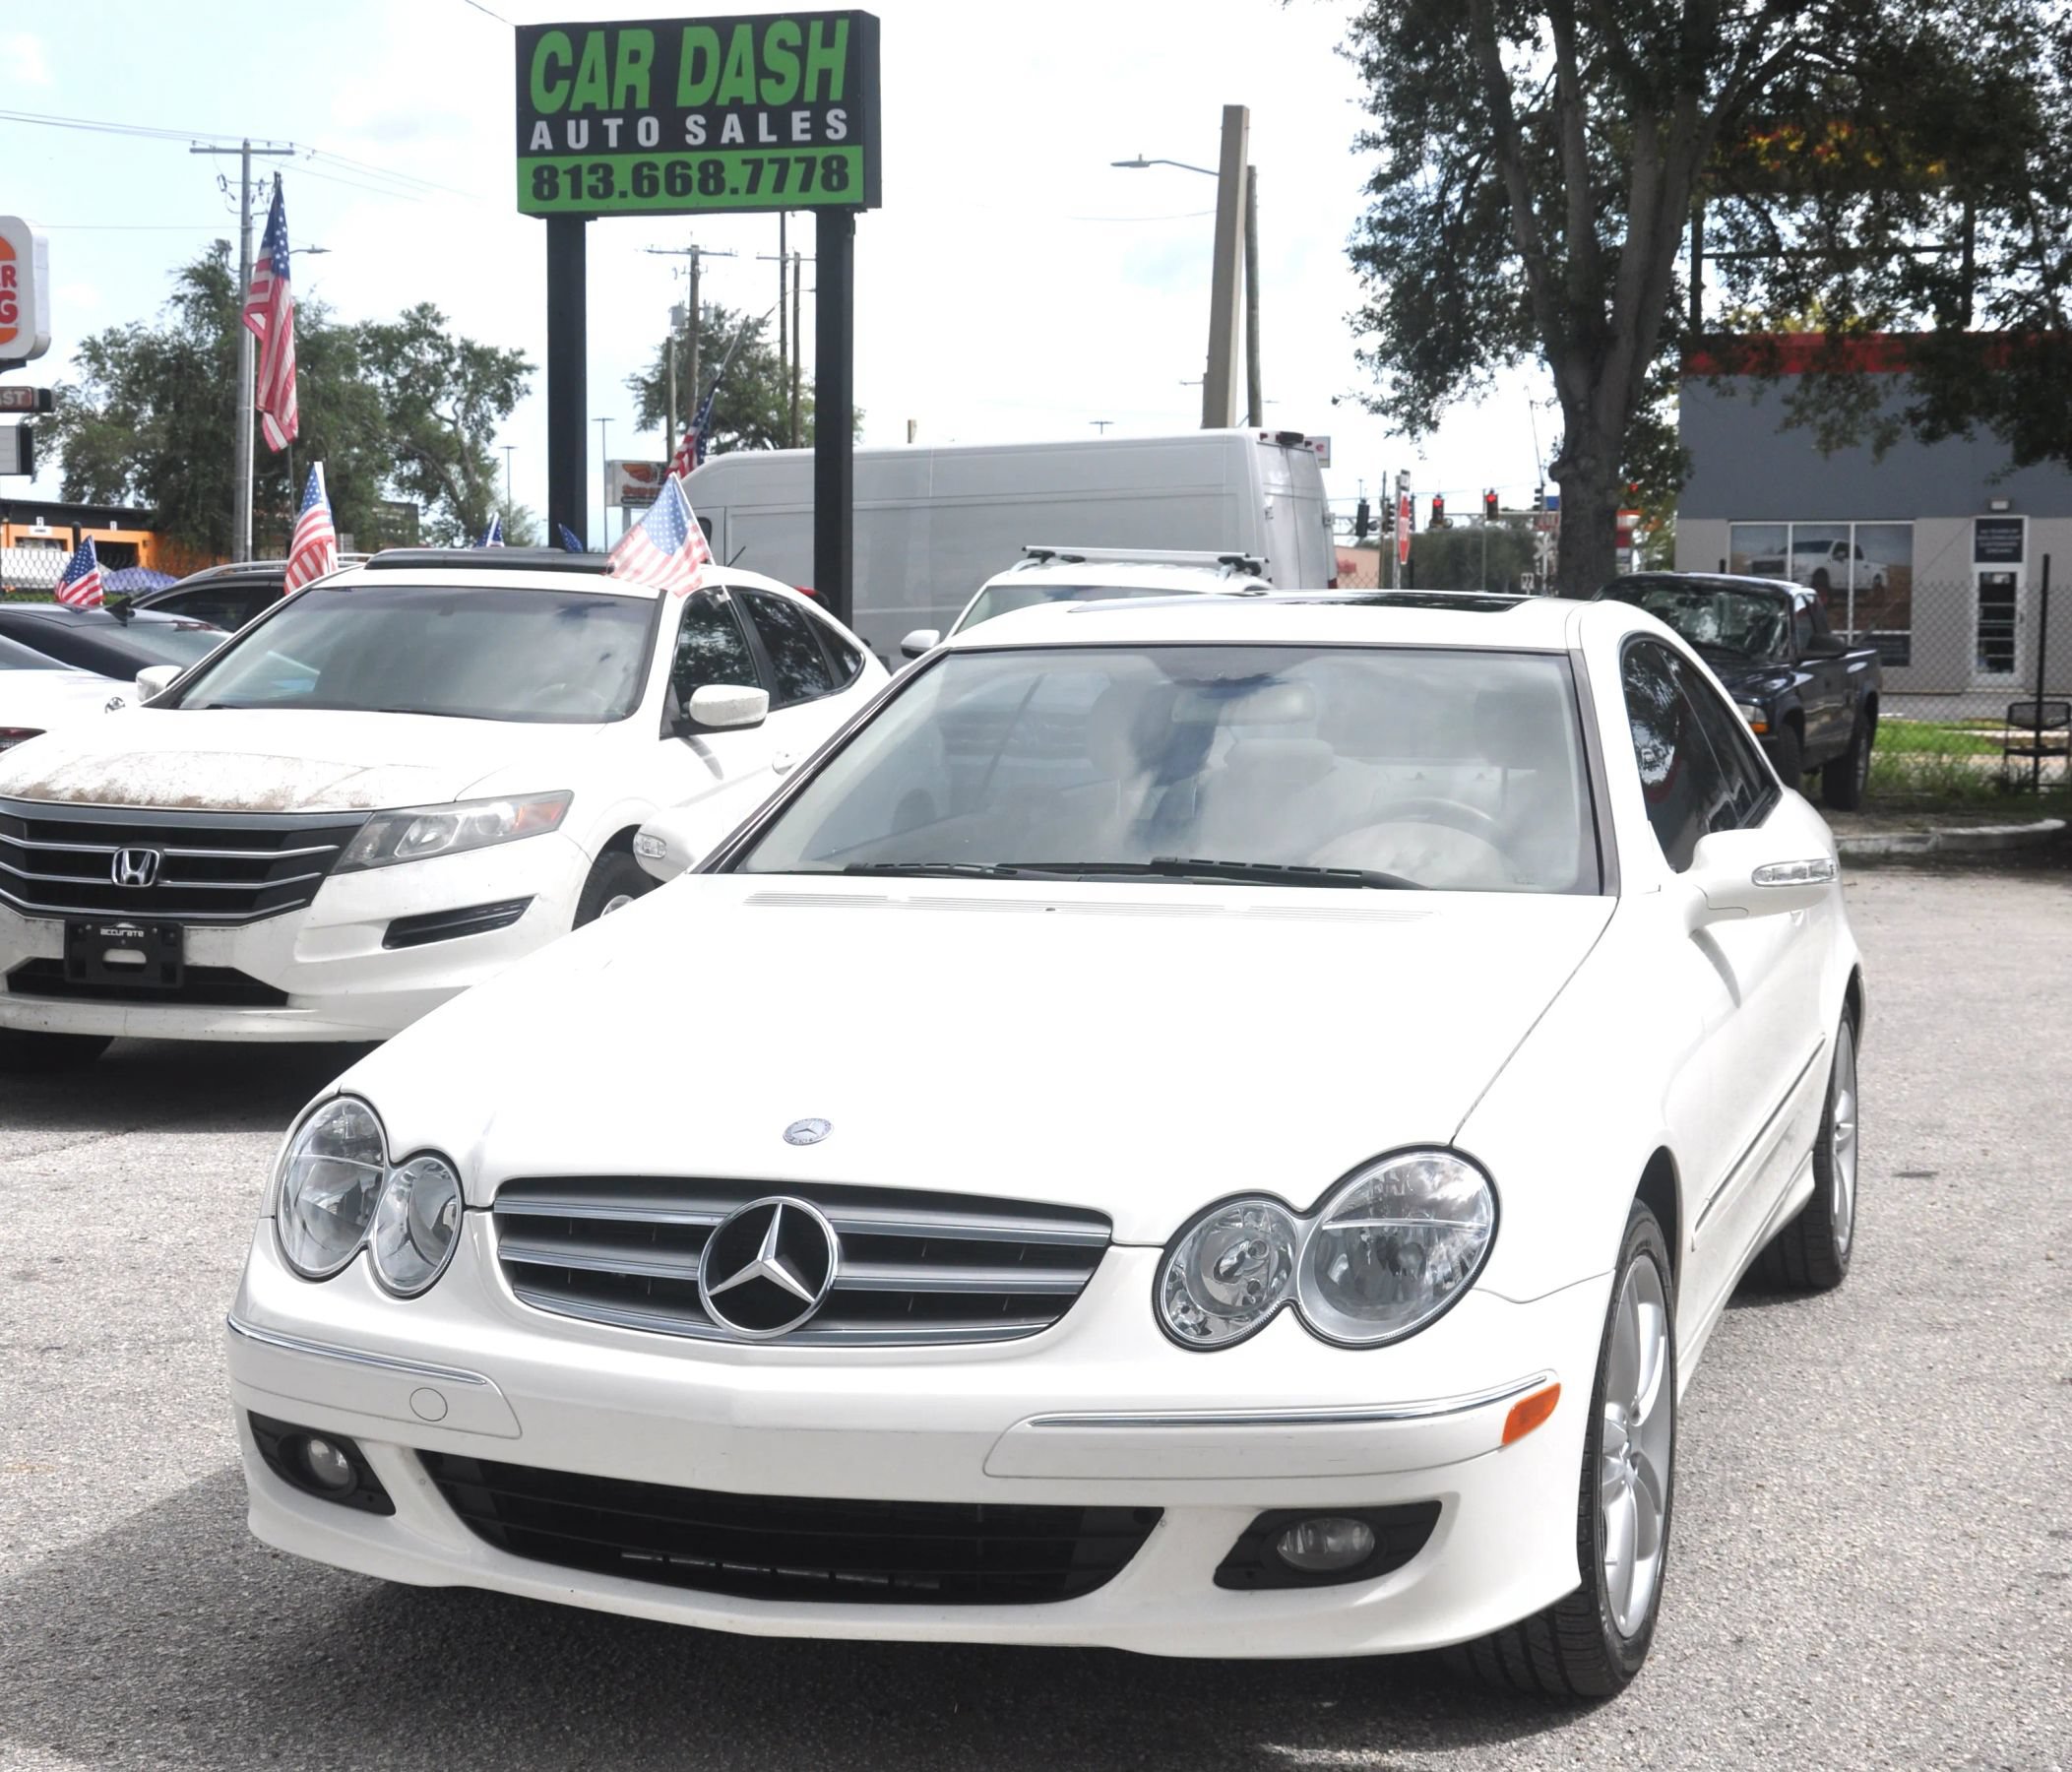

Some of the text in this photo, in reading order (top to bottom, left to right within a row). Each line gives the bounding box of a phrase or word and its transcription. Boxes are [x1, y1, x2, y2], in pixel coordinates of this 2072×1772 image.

[530, 19, 849, 114] CAR DASH
[530, 108, 848, 151] AUTO SALES
[532, 154, 849, 201] 813.668.7778
[0, 390, 26, 406] ST
